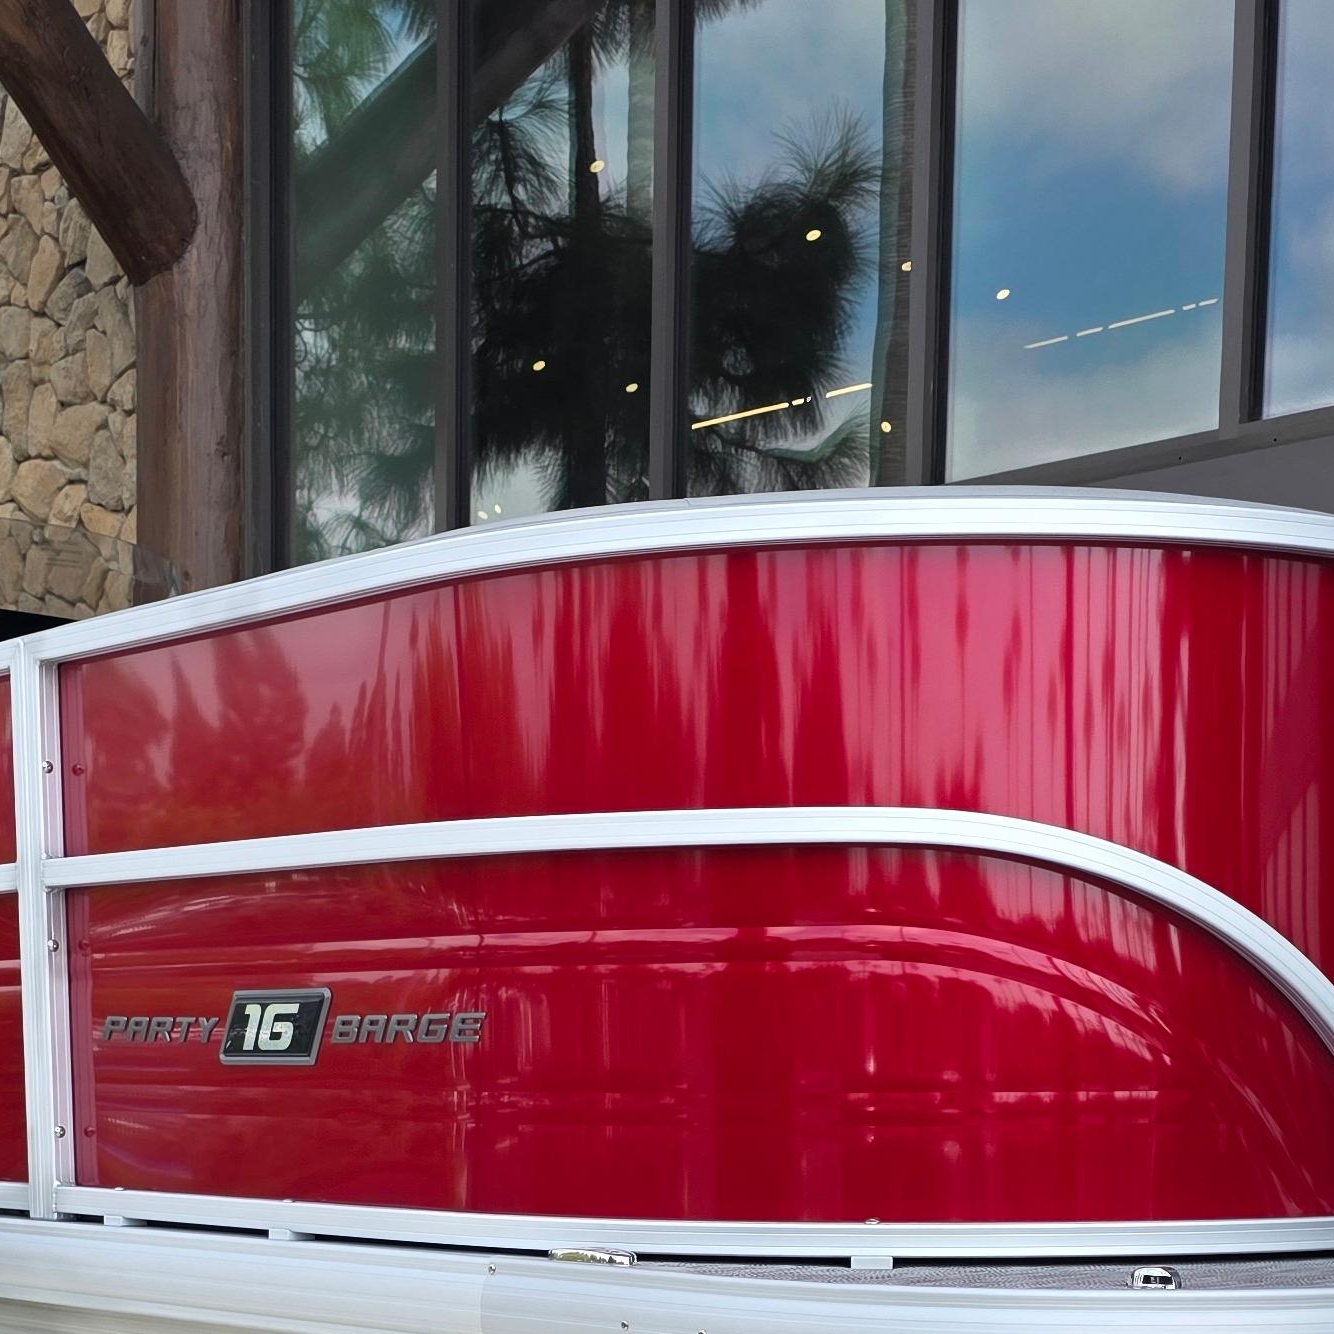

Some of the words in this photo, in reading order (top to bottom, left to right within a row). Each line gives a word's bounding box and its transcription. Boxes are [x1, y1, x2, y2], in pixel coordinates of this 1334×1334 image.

[101, 1015, 220, 1044] PARTY
[242, 1003, 300, 1051] 16
[330, 1012, 487, 1044] BARGE
